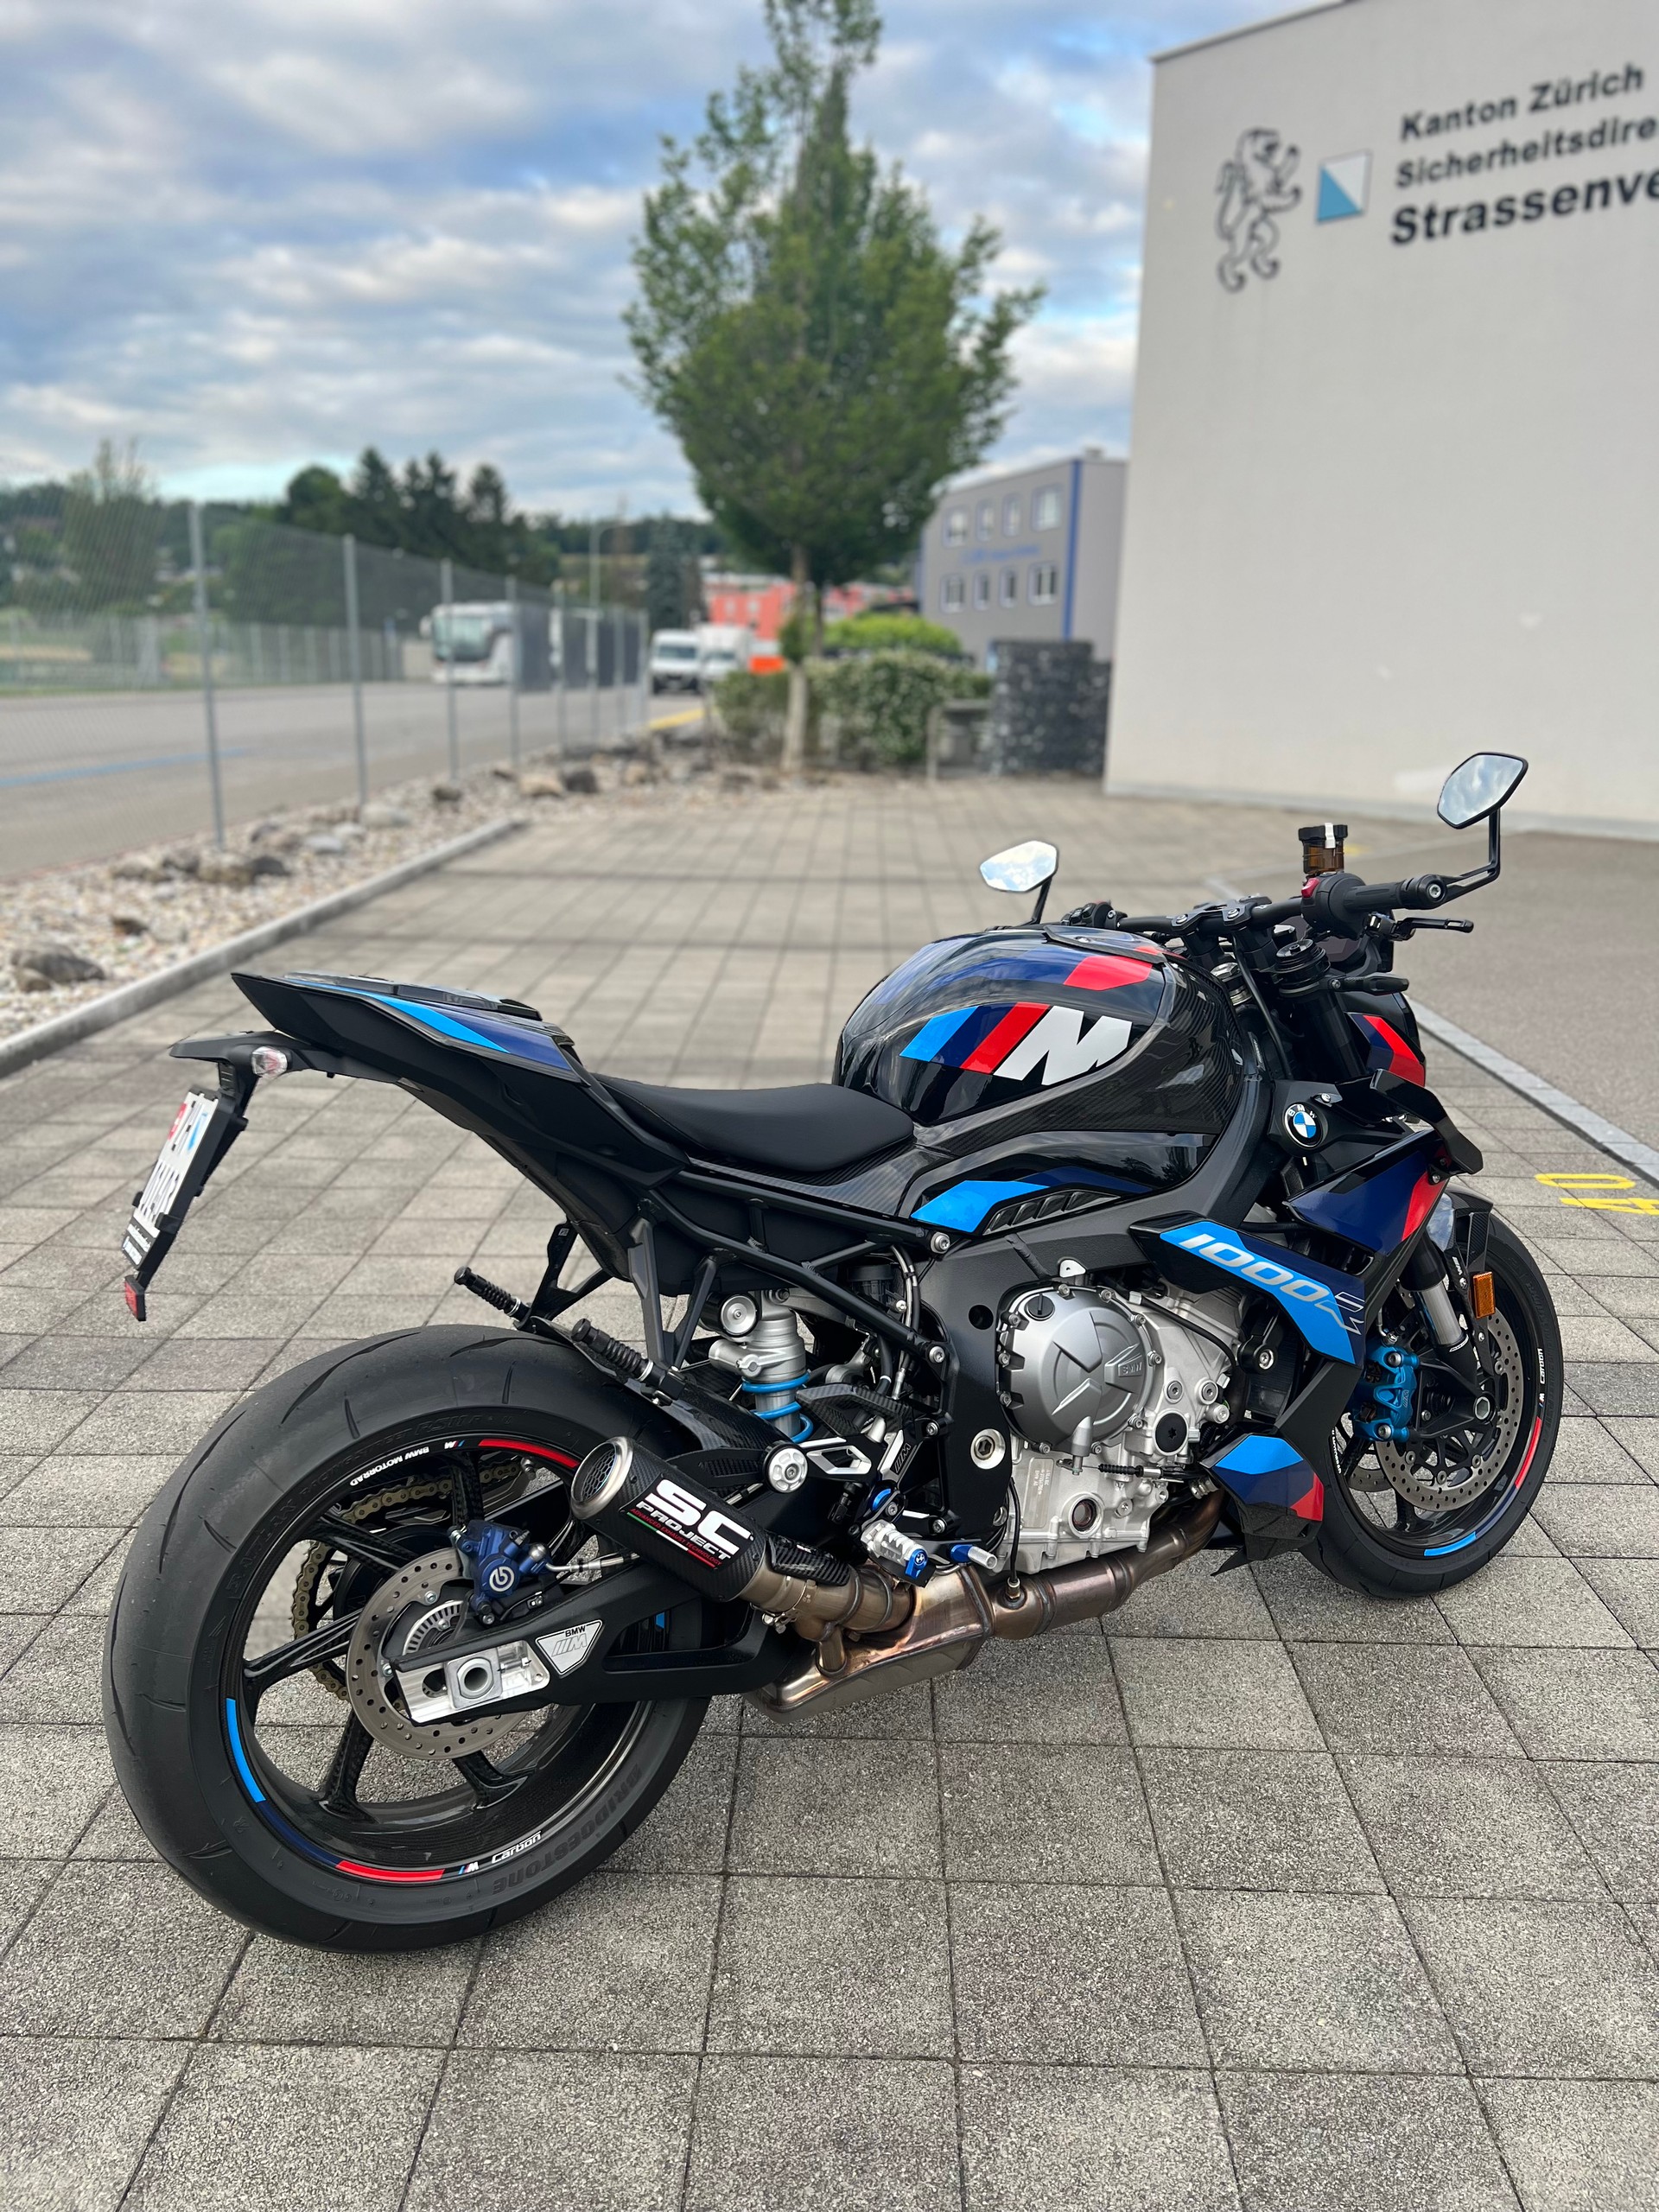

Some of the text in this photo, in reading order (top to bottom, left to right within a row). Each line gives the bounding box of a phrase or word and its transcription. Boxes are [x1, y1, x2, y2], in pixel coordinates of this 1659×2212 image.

[1400, 62, 1644, 142] Kanton Zürich
[1395, 114, 1657, 189] Sicherheitsdire
[993, 1005, 1133, 1086] M
[1287, 1103, 1318, 1119] BMW
[1537, 1348, 1546, 1384] Carbon
[349, 1453, 404, 1486] MOTORRAD
[402, 1446, 429, 1461] BMW
[629, 1508, 662, 1529] ADVANCED
[685, 1541, 722, 1566] TECHNOLOGY
[635, 1500, 732, 1560] PROJECT
[645, 1478, 752, 1556] SC
[564, 1625, 586, 1637] BMW
[492, 1763, 643, 1895] BRIDGESTONE
[492, 1831, 542, 1864] Carbon
